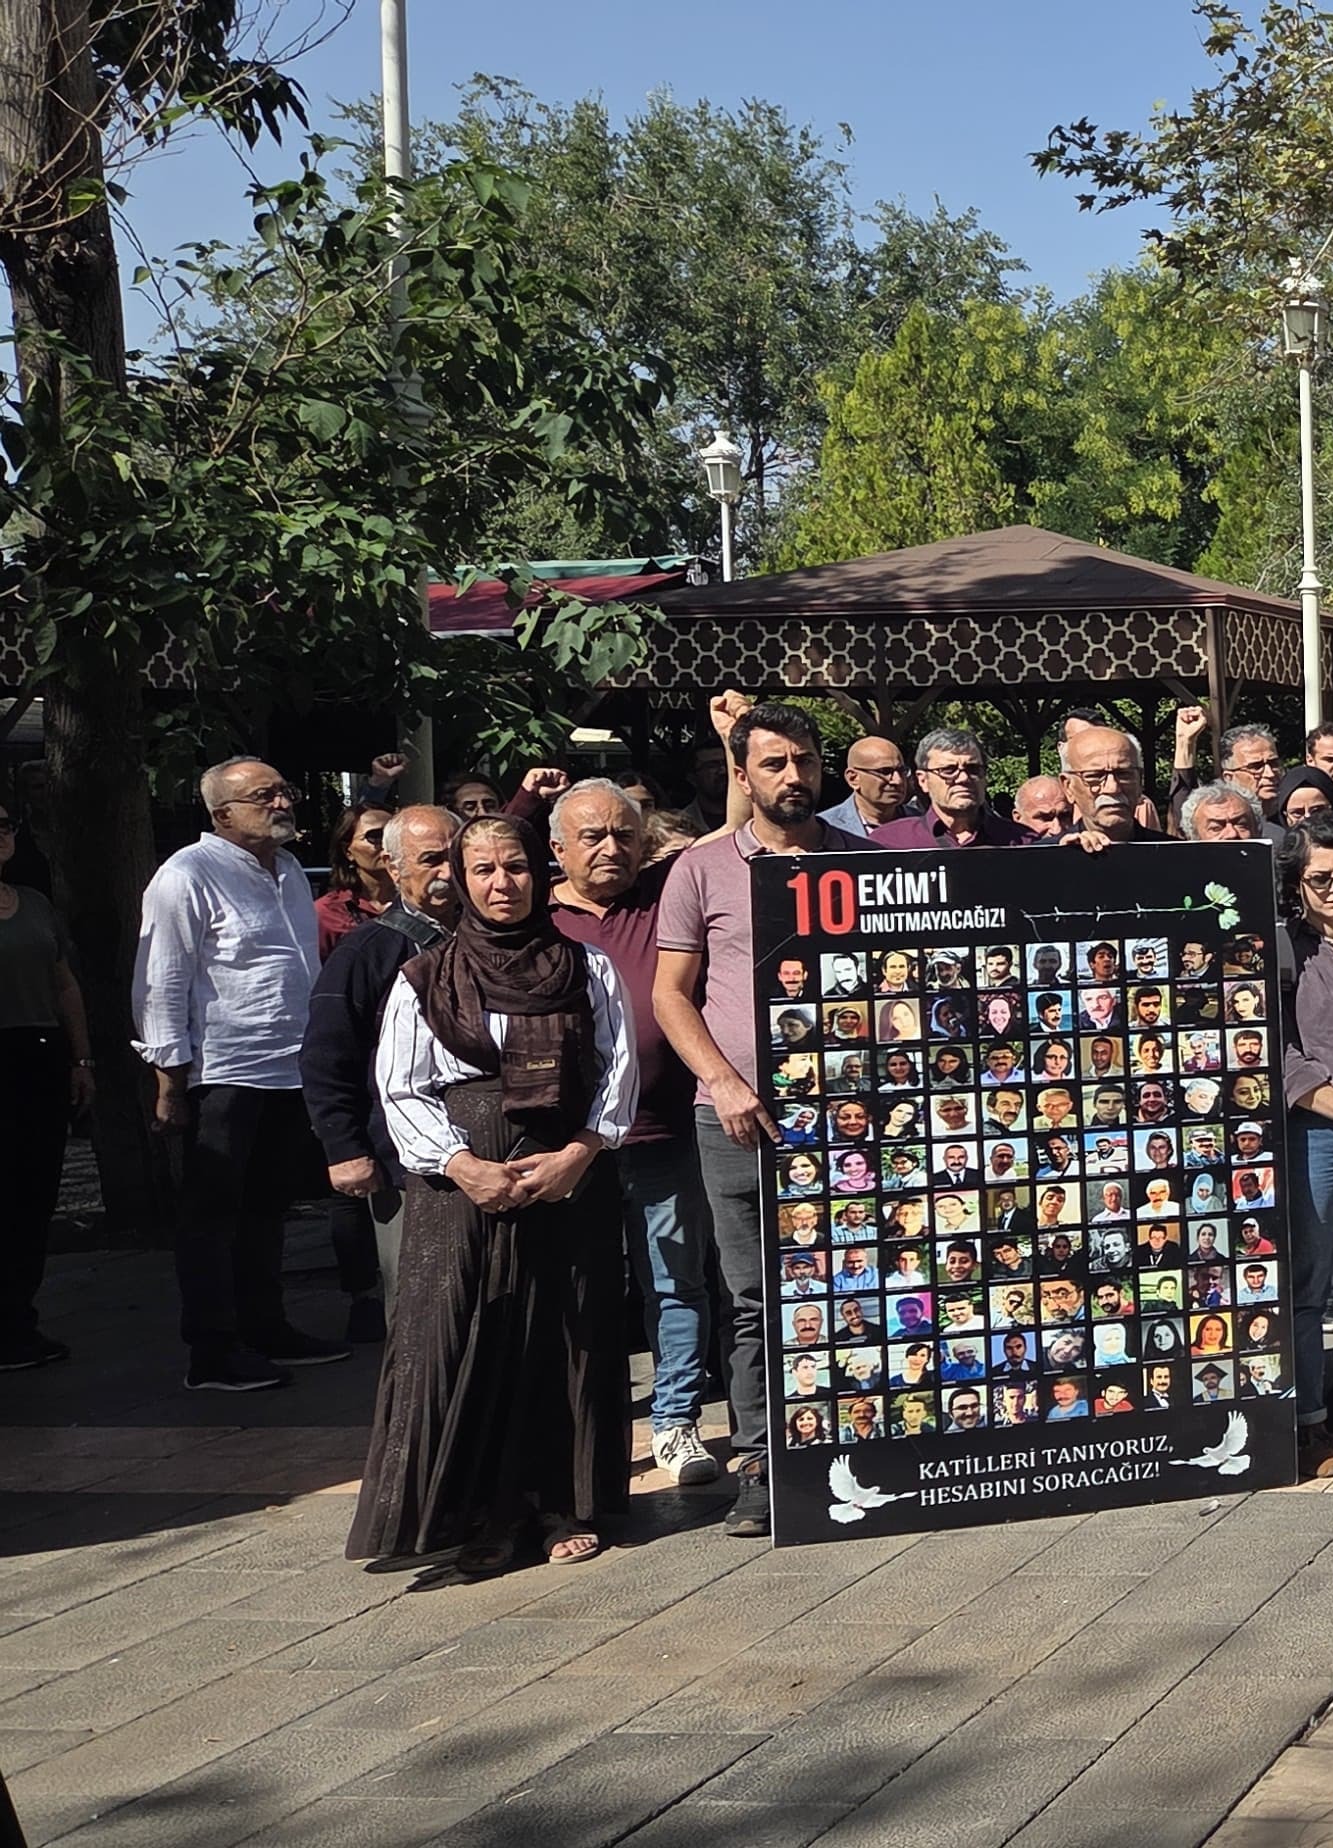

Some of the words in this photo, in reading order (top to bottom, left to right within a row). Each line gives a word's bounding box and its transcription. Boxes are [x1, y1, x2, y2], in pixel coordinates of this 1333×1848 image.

[786, 868, 857, 937] 10
[857, 864, 949, 908] EKİM'İ
[859, 904, 1007, 934] UNUTMAYACAĞIZ!
[919, 1448, 1037, 1481] KATİLLERİ
[1042, 1434, 1175, 1466] TANIYORUZ,
[920, 1477, 1027, 1507] HESABINI
[1031, 1460, 1161, 1494] SORACAĞIZ!
